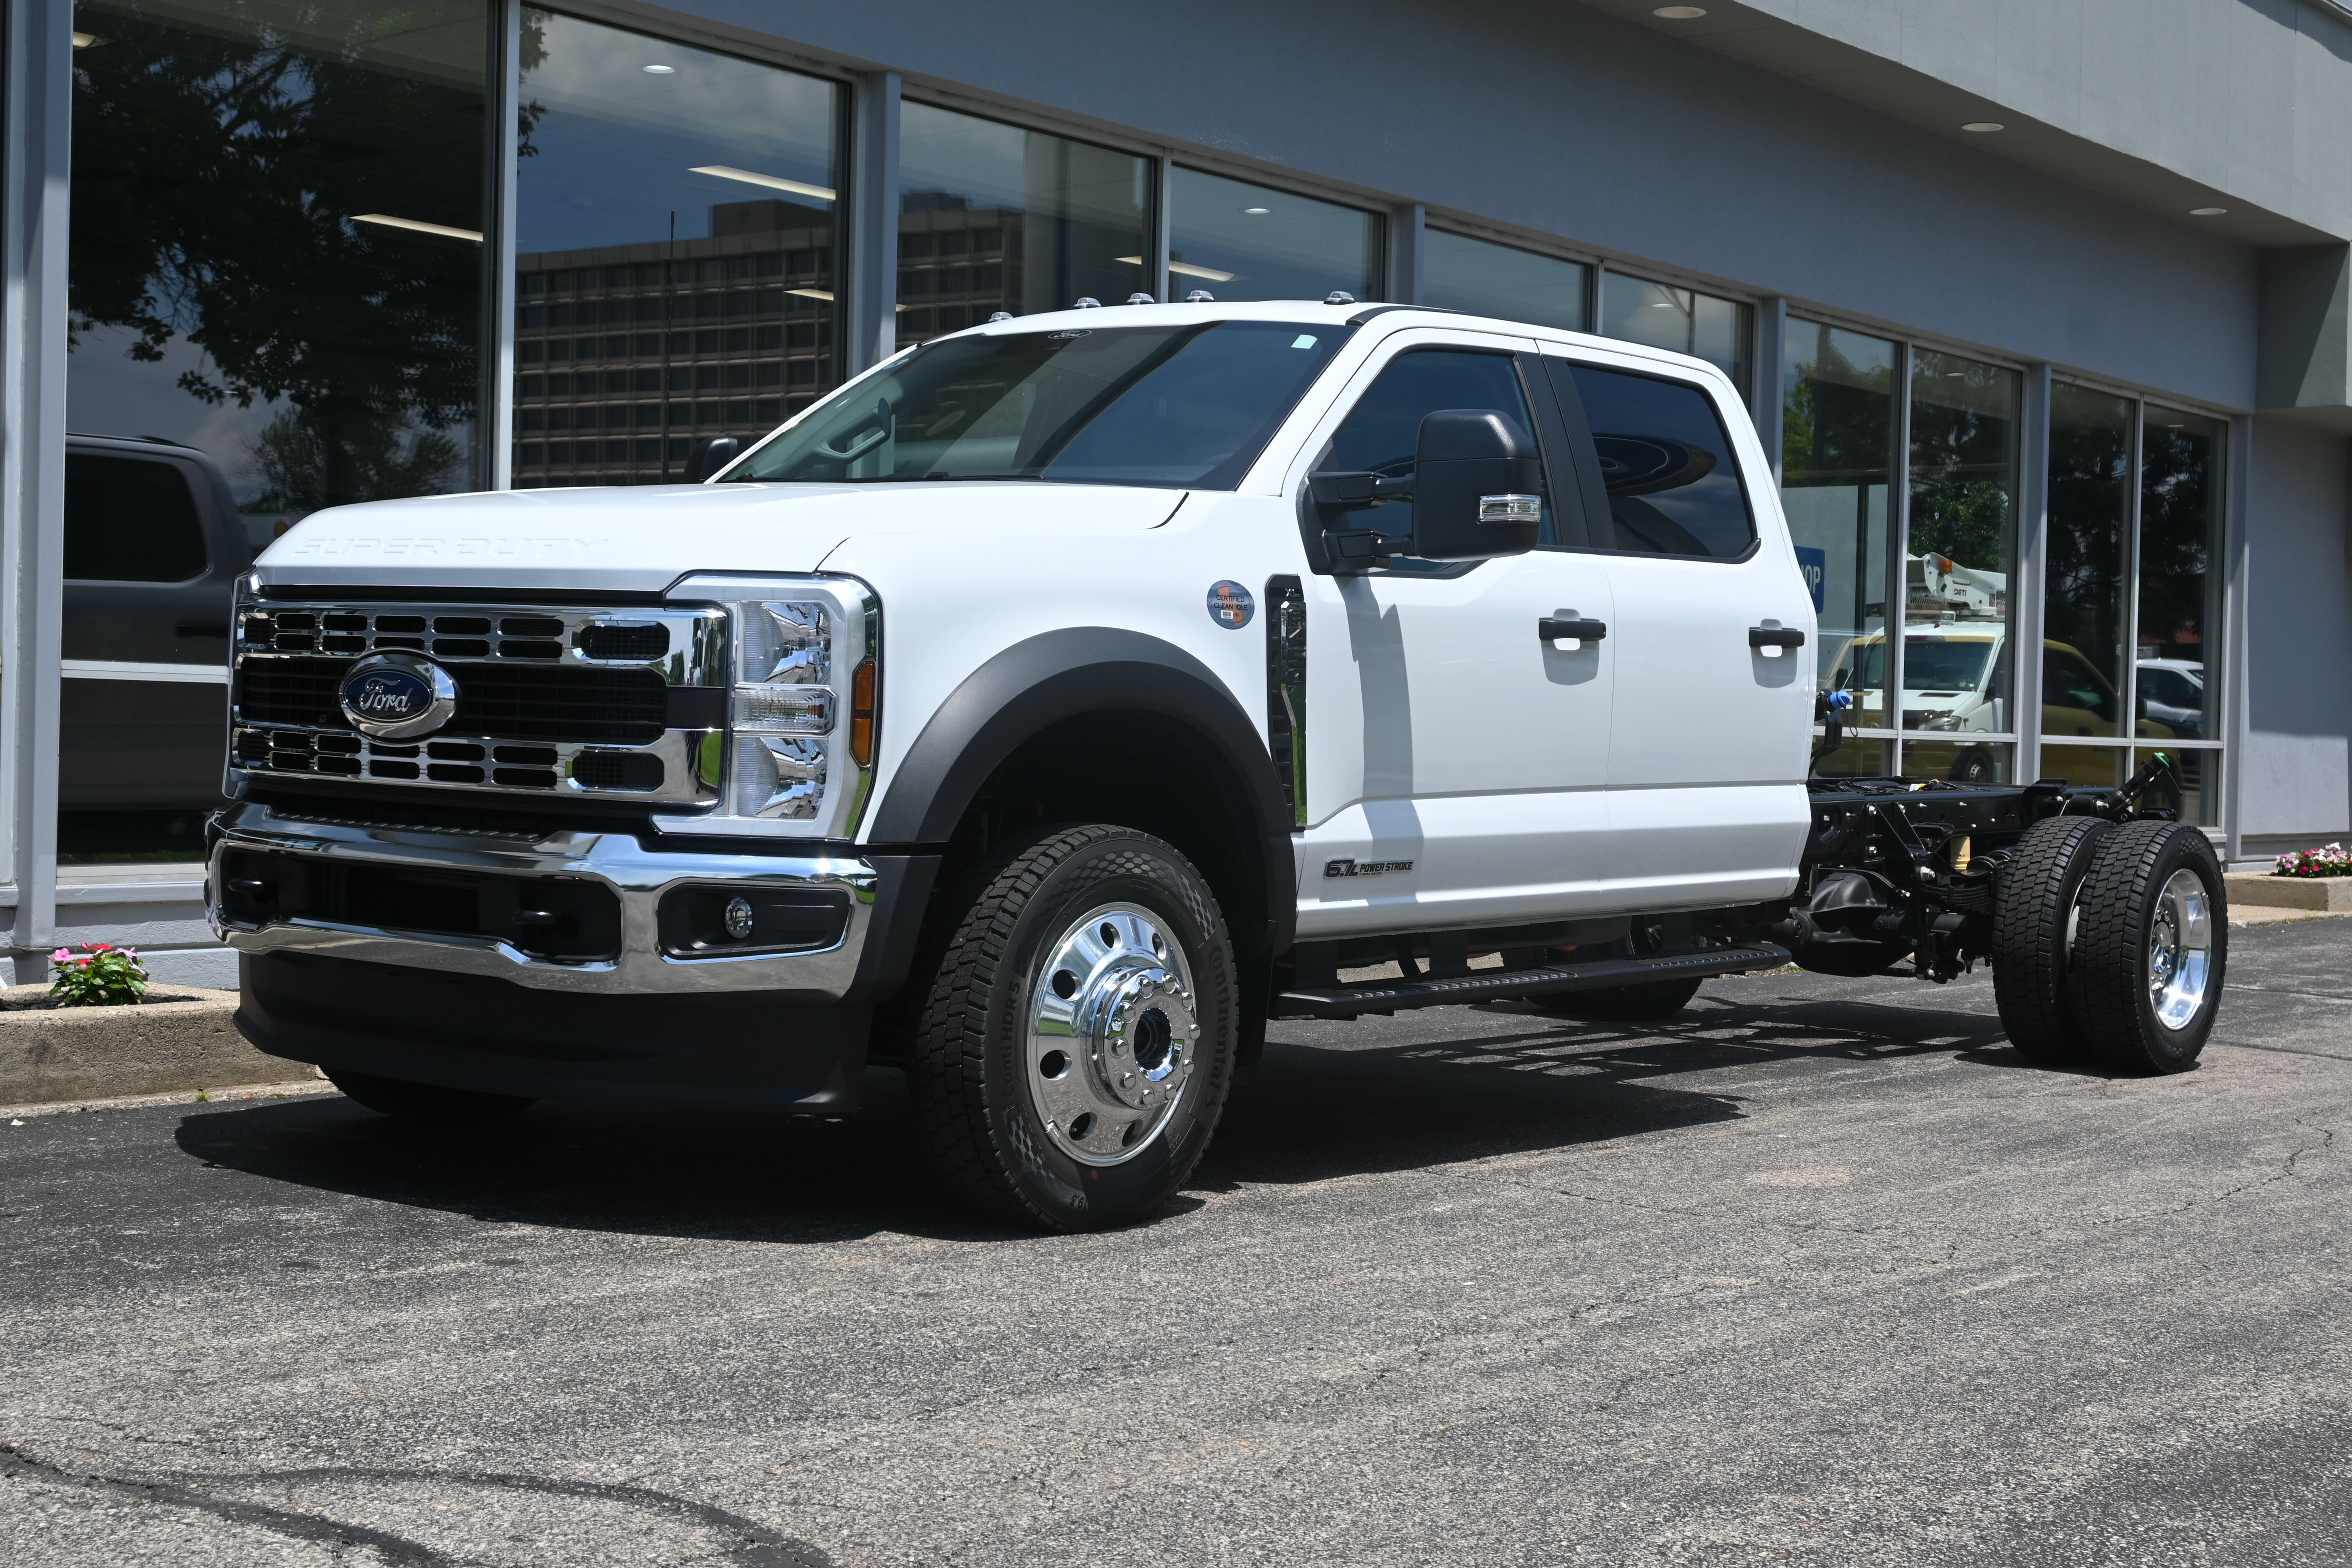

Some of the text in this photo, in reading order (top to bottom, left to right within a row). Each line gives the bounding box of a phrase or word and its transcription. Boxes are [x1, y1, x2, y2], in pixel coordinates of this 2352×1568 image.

[292, 538, 609, 557] SUPER DUTY
[1801, 564, 1821, 594] OP
[1216, 594, 1245, 602] CERTIFIED
[1285, 588, 1300, 597] XL
[359, 677, 413, 712] Ford
[1325, 859, 1413, 878] 6.7L POWER STROKE
[1000, 980, 1021, 1097] Conti HDR 5
